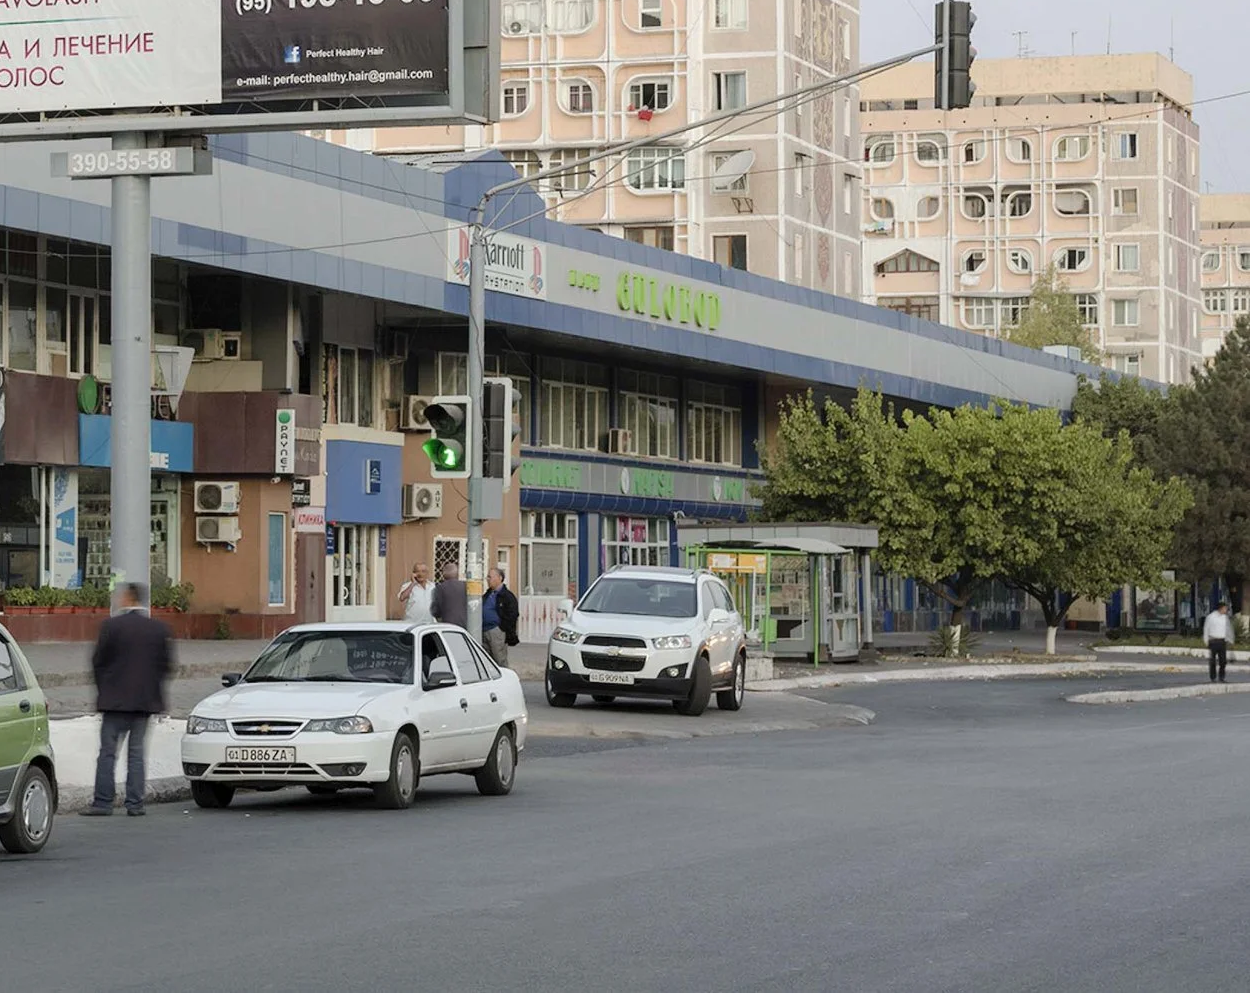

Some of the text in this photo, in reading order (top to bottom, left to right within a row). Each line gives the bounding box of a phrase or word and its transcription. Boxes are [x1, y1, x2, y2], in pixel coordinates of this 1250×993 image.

[24, 38, 40, 59] И
[53, 32, 154, 57] ЛЕЧЕНИЕ
[306, 48, 334, 58] Perfect
[335, 47, 365, 58] Healthy
[367, 46, 384, 56] Hair
[236, 68, 433, 87] e-mail: perfecthealthy.hair@gmail.com
[72, 150, 172, 173] 390-55-58
[280, 425, 288, 472] PAYNET
[228, 750, 239, 760] 01
